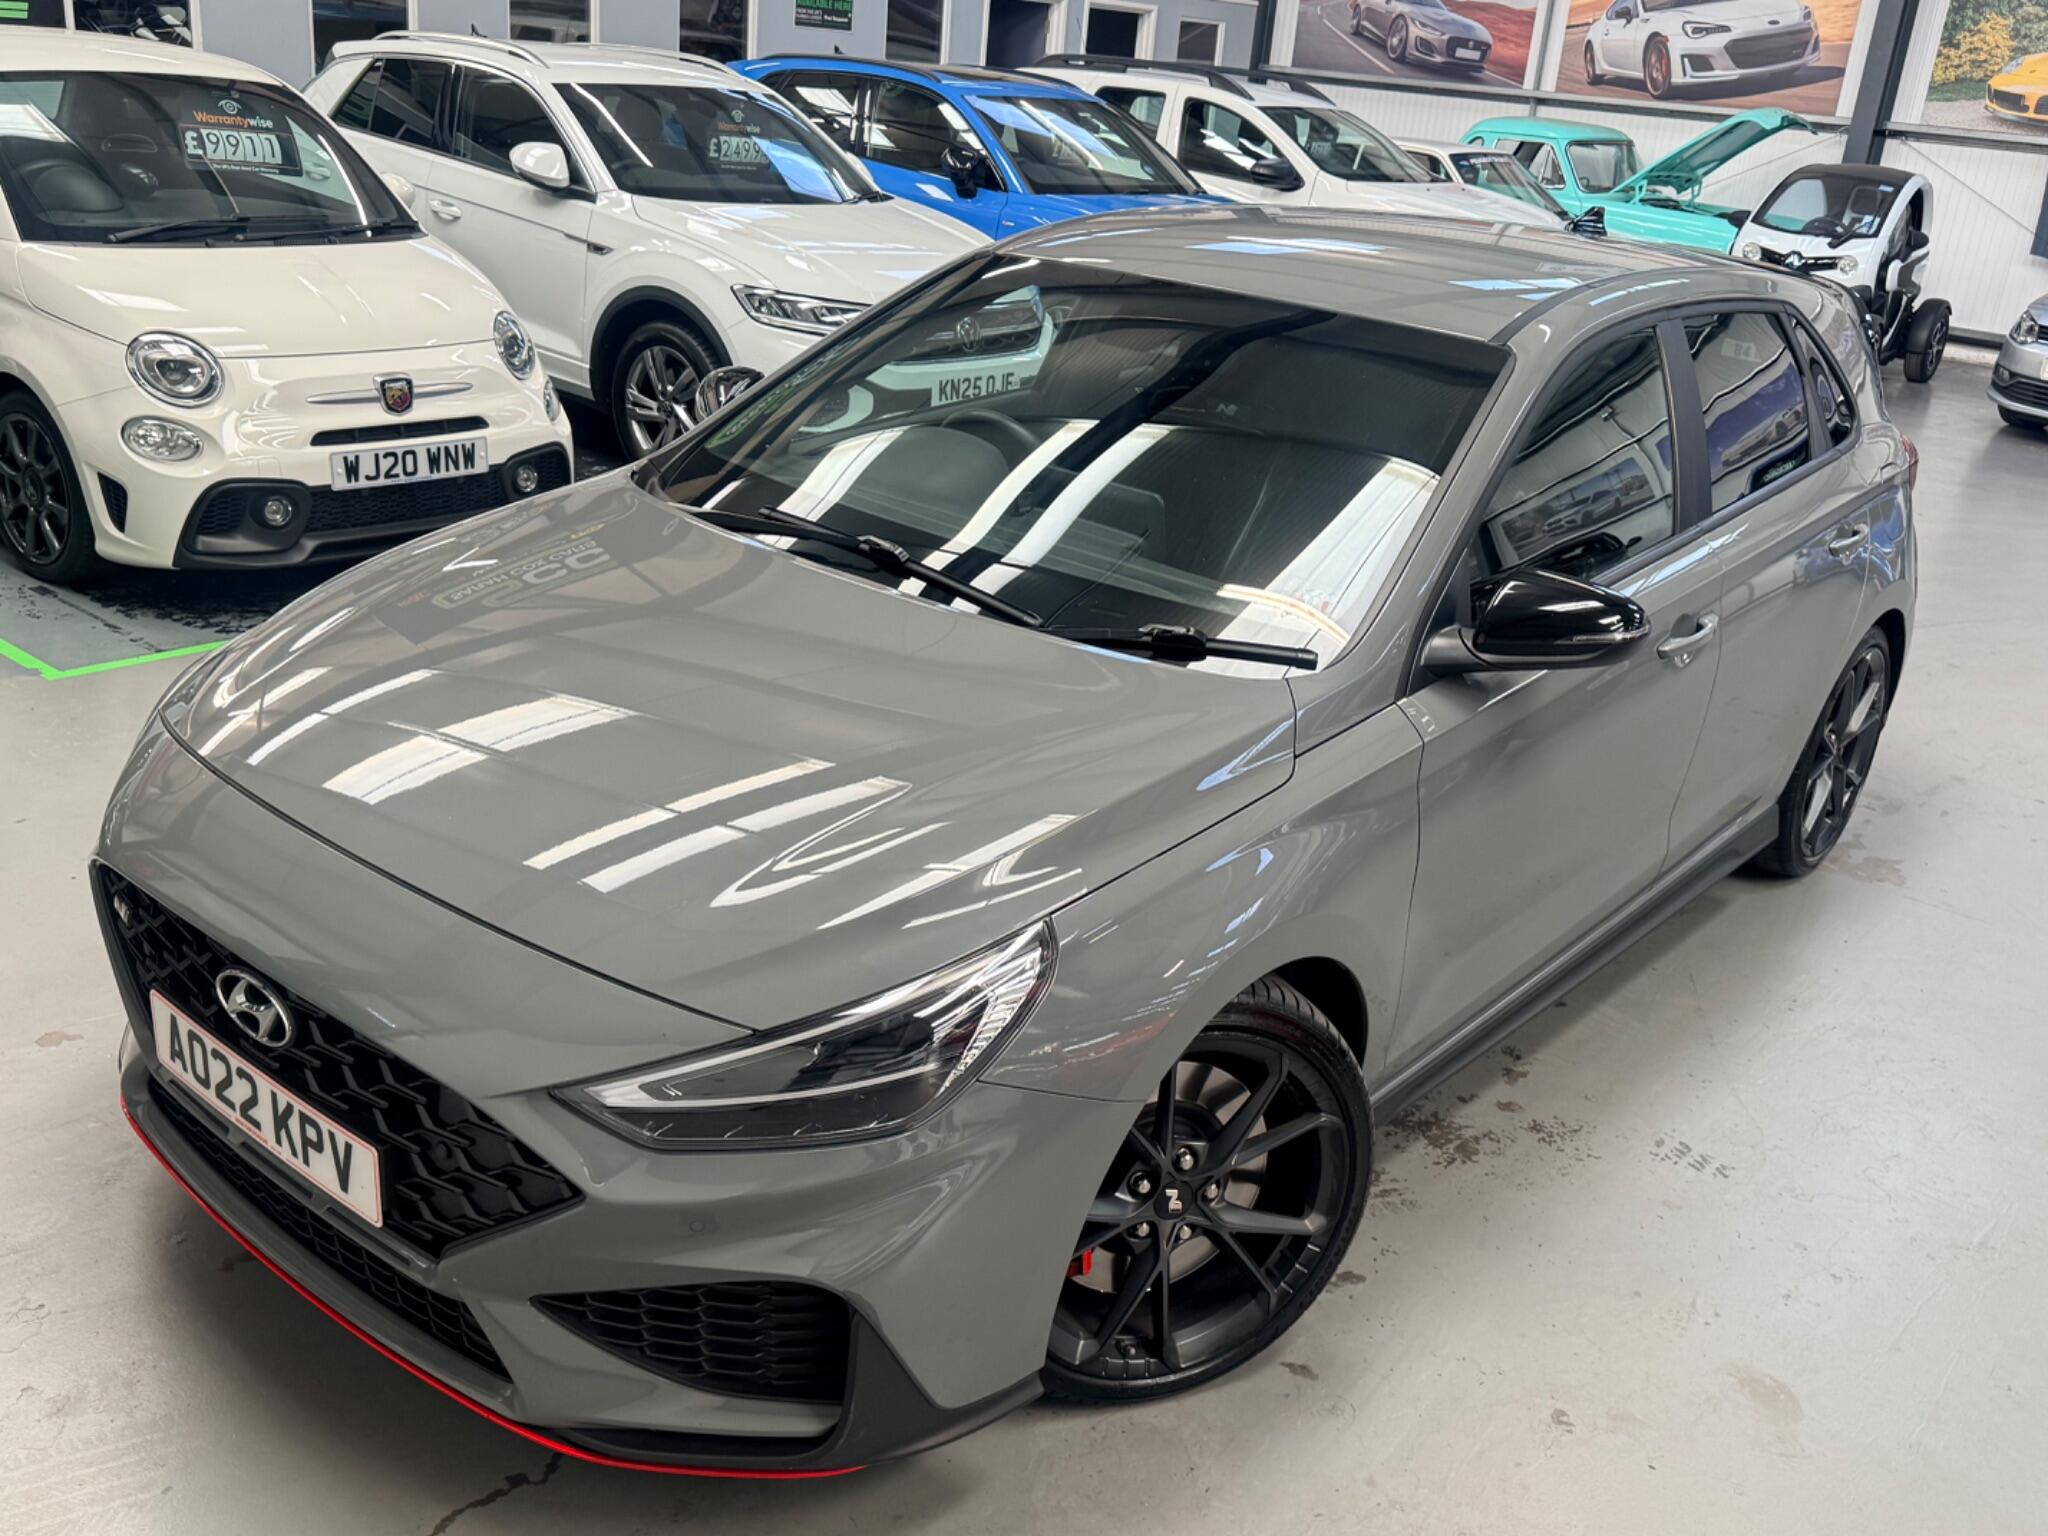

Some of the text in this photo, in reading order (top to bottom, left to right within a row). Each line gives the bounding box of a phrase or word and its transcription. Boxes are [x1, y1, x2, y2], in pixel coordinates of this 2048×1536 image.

[193, 110, 274, 129] Warrantywise
[938, 376, 982, 402] KN25
[343, 442, 476, 484] WJ20 WNW
[169, 1012, 353, 1195] AO22 KPV
